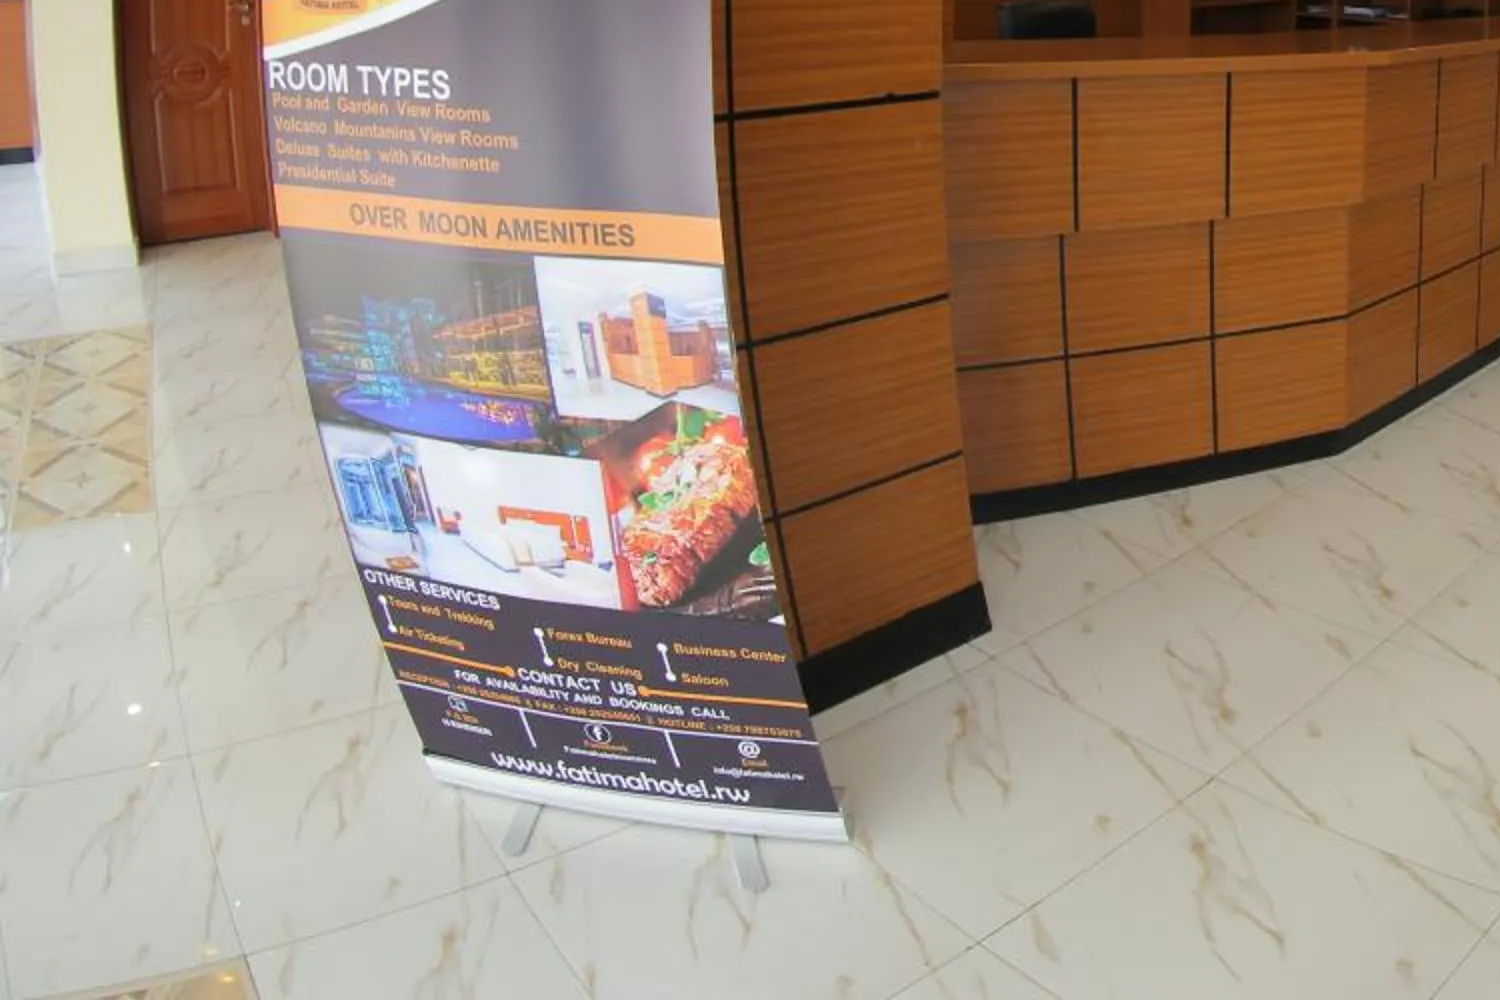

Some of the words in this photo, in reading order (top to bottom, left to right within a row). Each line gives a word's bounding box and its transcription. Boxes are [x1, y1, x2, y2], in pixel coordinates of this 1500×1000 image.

[269, 61, 349, 94] ROOM
[355, 65, 451, 100] TYPES
[272, 91, 301, 108] Pool
[304, 95, 330, 111] and
[337, 95, 389, 117] Garden
[396, 100, 431, 118] View
[435, 103, 492, 123] Rooms
[273, 116, 327, 136] Volcano
[419, 126, 457, 145] View
[461, 129, 519, 150] Rooms
[326, 143, 371, 162] Suites
[379, 148, 409, 166] with
[411, 150, 501, 174] Kitchenette
[277, 161, 356, 184] Presidential
[359, 168, 396, 188] Suite
[350, 202, 408, 230] OVER
[418, 210, 488, 239] MOON
[495, 218, 636, 248] AMENITIES
[364, 568, 418, 593] OTHER
[419, 581, 501, 611] SERVICES
[421, 604, 441, 617] and
[585, 632, 633, 649] Bureau
[673, 643, 737, 659] Business
[740, 647, 787, 663] Center
[517, 667, 601, 692] CONTACT
[609, 680, 638, 697] US
[557, 658, 580, 673] Dry
[585, 661, 643, 681] Cleaning
[681, 672, 729, 687] Saloon
[453, 669, 481, 685] FOR
[485, 677, 570, 702] AVAILABILITY
[573, 693, 604, 706] AND
[608, 696, 685, 716] BOOKINGS
[690, 706, 731, 721] CALL
[490, 751, 751, 803] www.fatimahotel.rw
